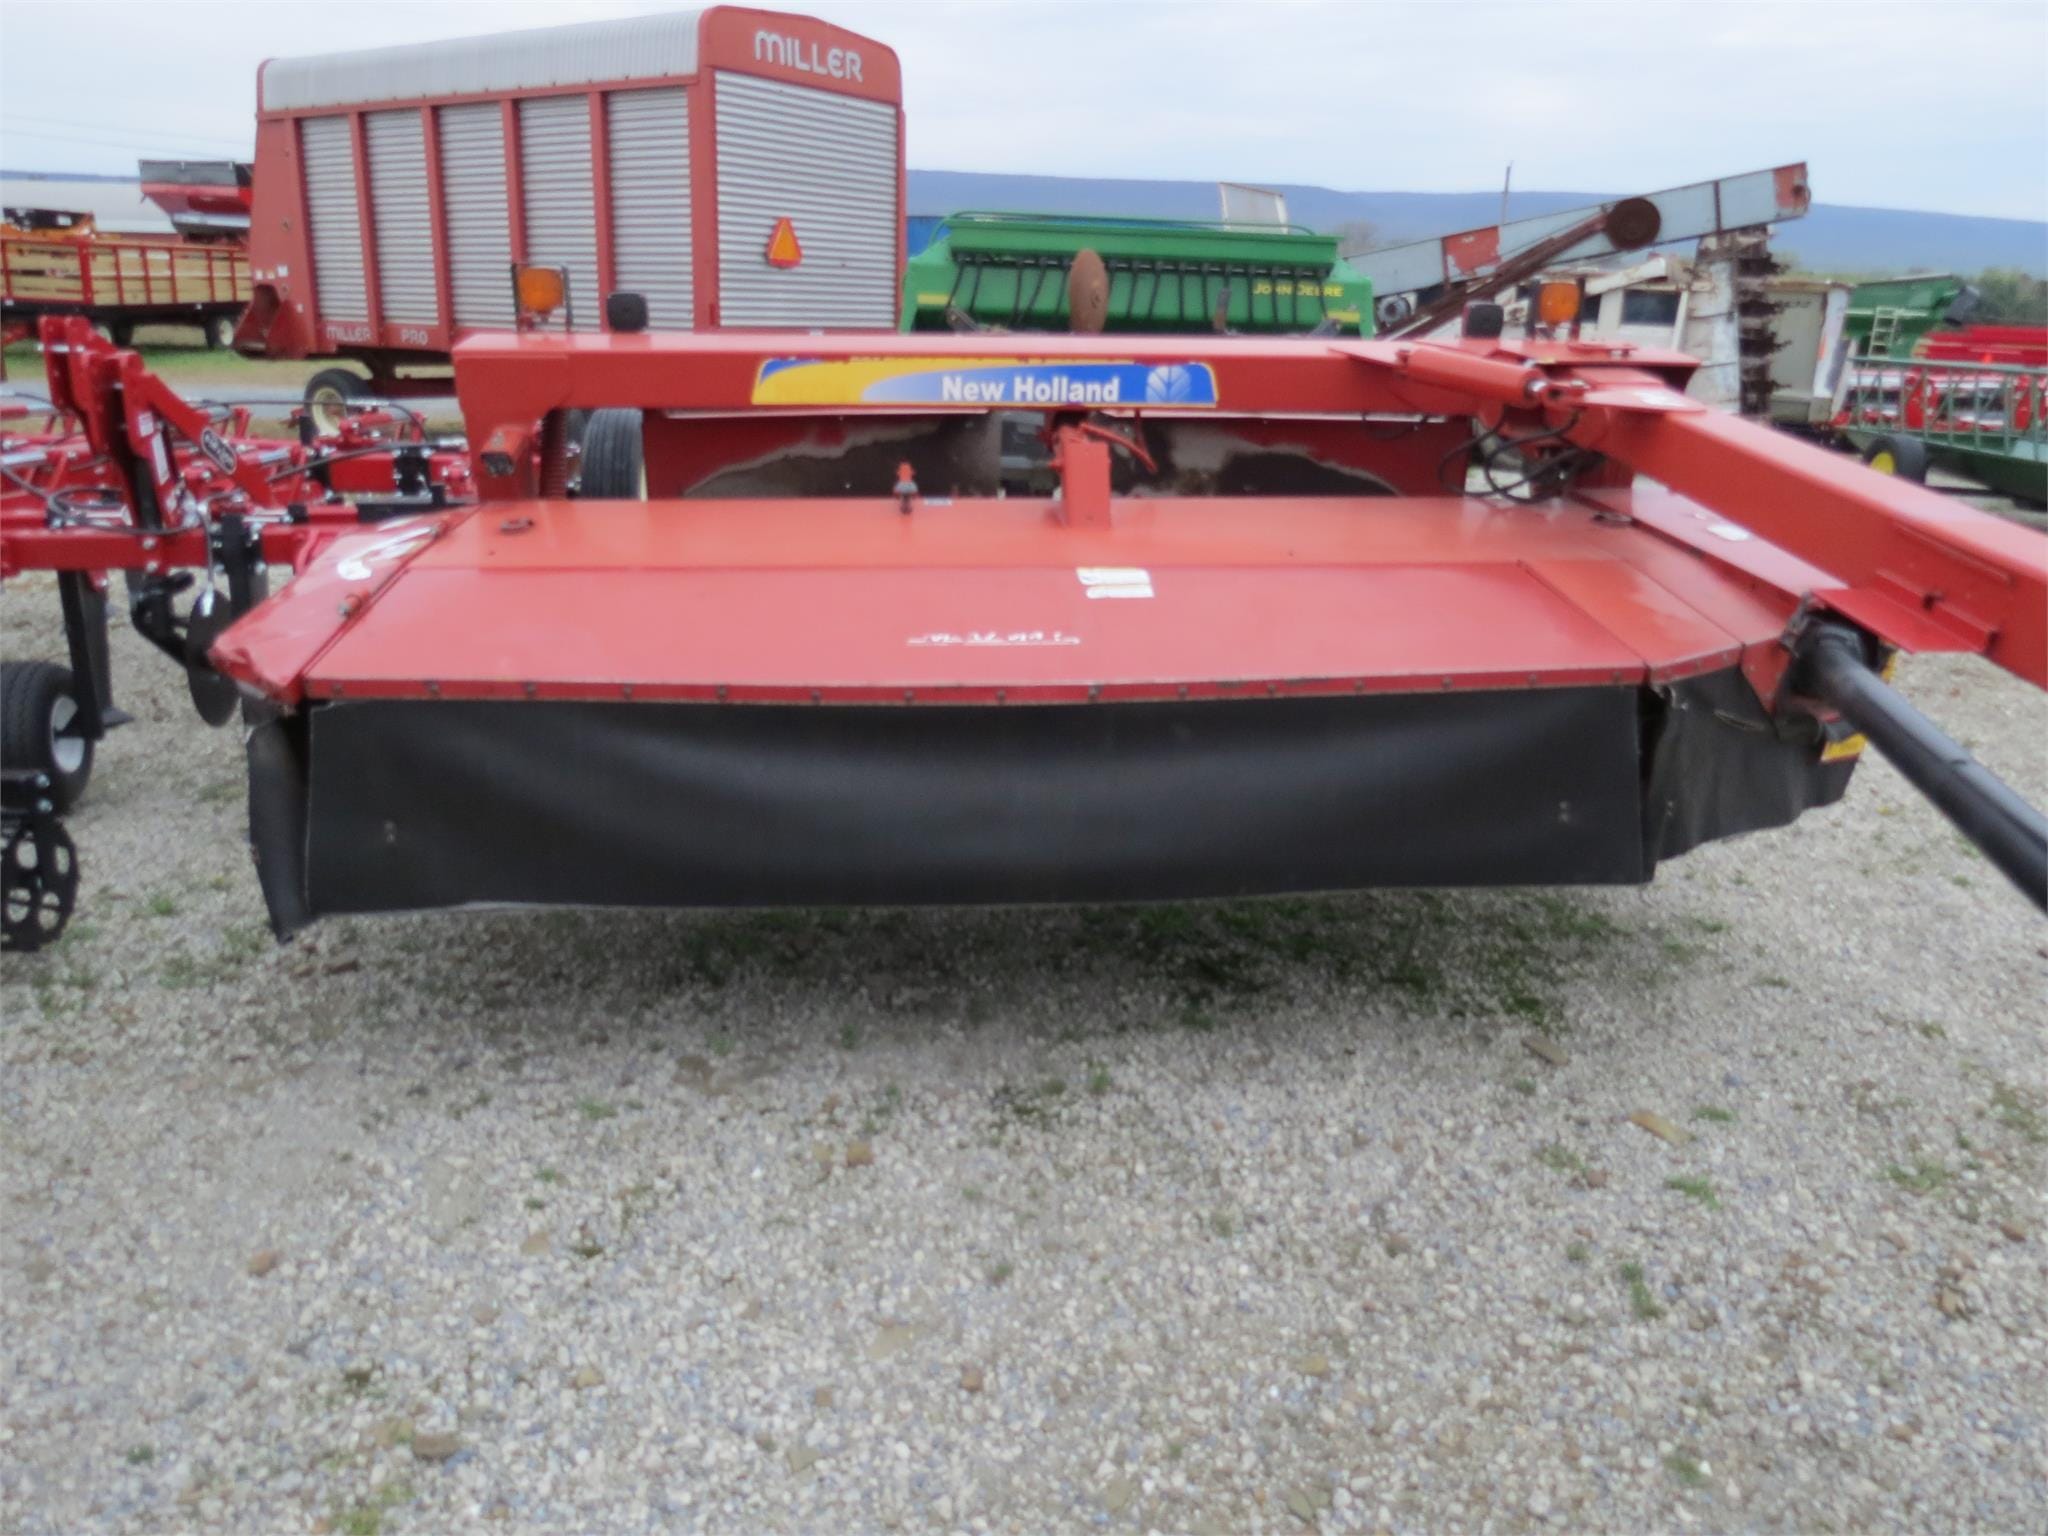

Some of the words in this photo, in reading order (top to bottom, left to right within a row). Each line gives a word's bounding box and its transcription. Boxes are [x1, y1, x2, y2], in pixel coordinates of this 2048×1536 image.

[755, 30, 863, 83] MILLER
[326, 325, 371, 343] MILLER
[401, 329, 428, 346] PRO
[942, 376, 1004, 401] New
[1014, 376, 1120, 402] Holland
